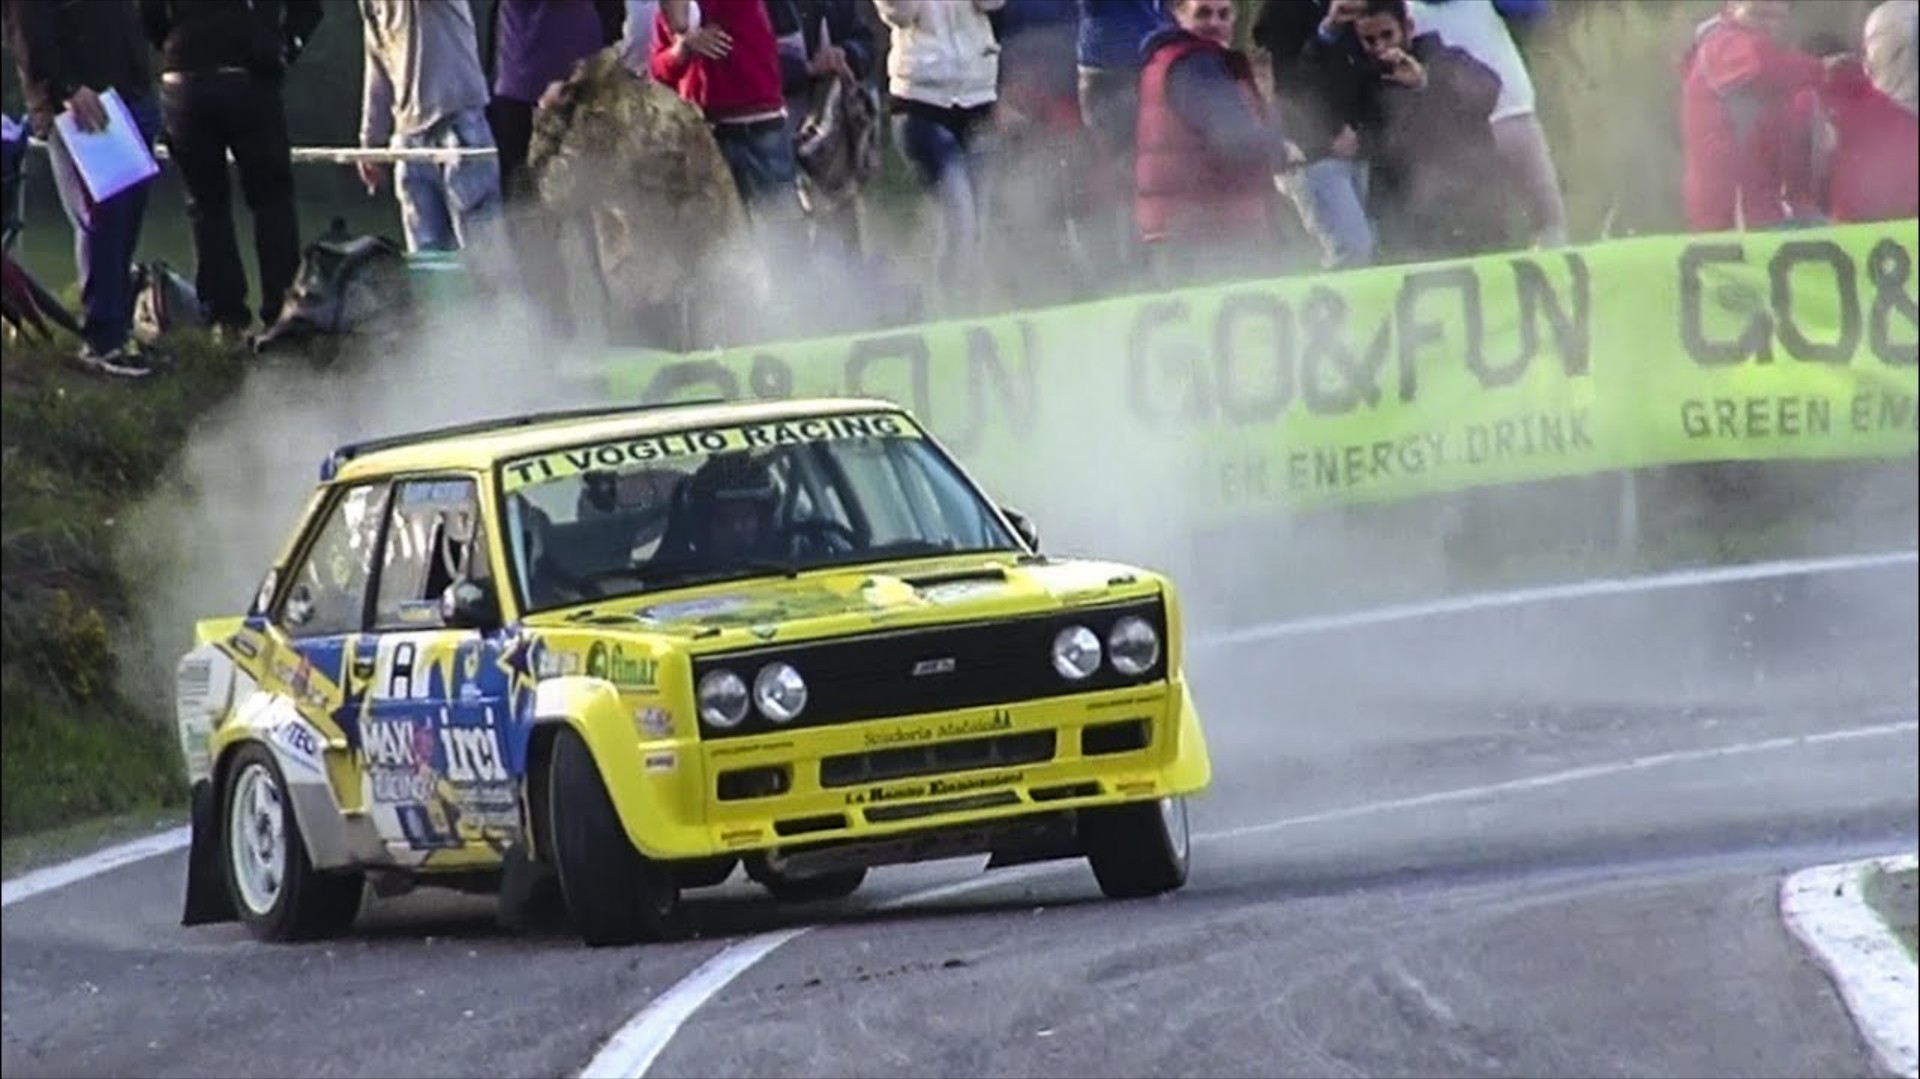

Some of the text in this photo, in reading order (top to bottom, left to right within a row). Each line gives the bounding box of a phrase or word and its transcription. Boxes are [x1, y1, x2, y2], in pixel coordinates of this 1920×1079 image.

[1127, 252, 1593, 428] GO&FUN
[508, 414, 900, 484] TI VOGLIO RACING
[1289, 429, 1446, 489] ENERGY
[1465, 408, 1595, 463] DRINK
[1680, 397, 1831, 439] GREEN
